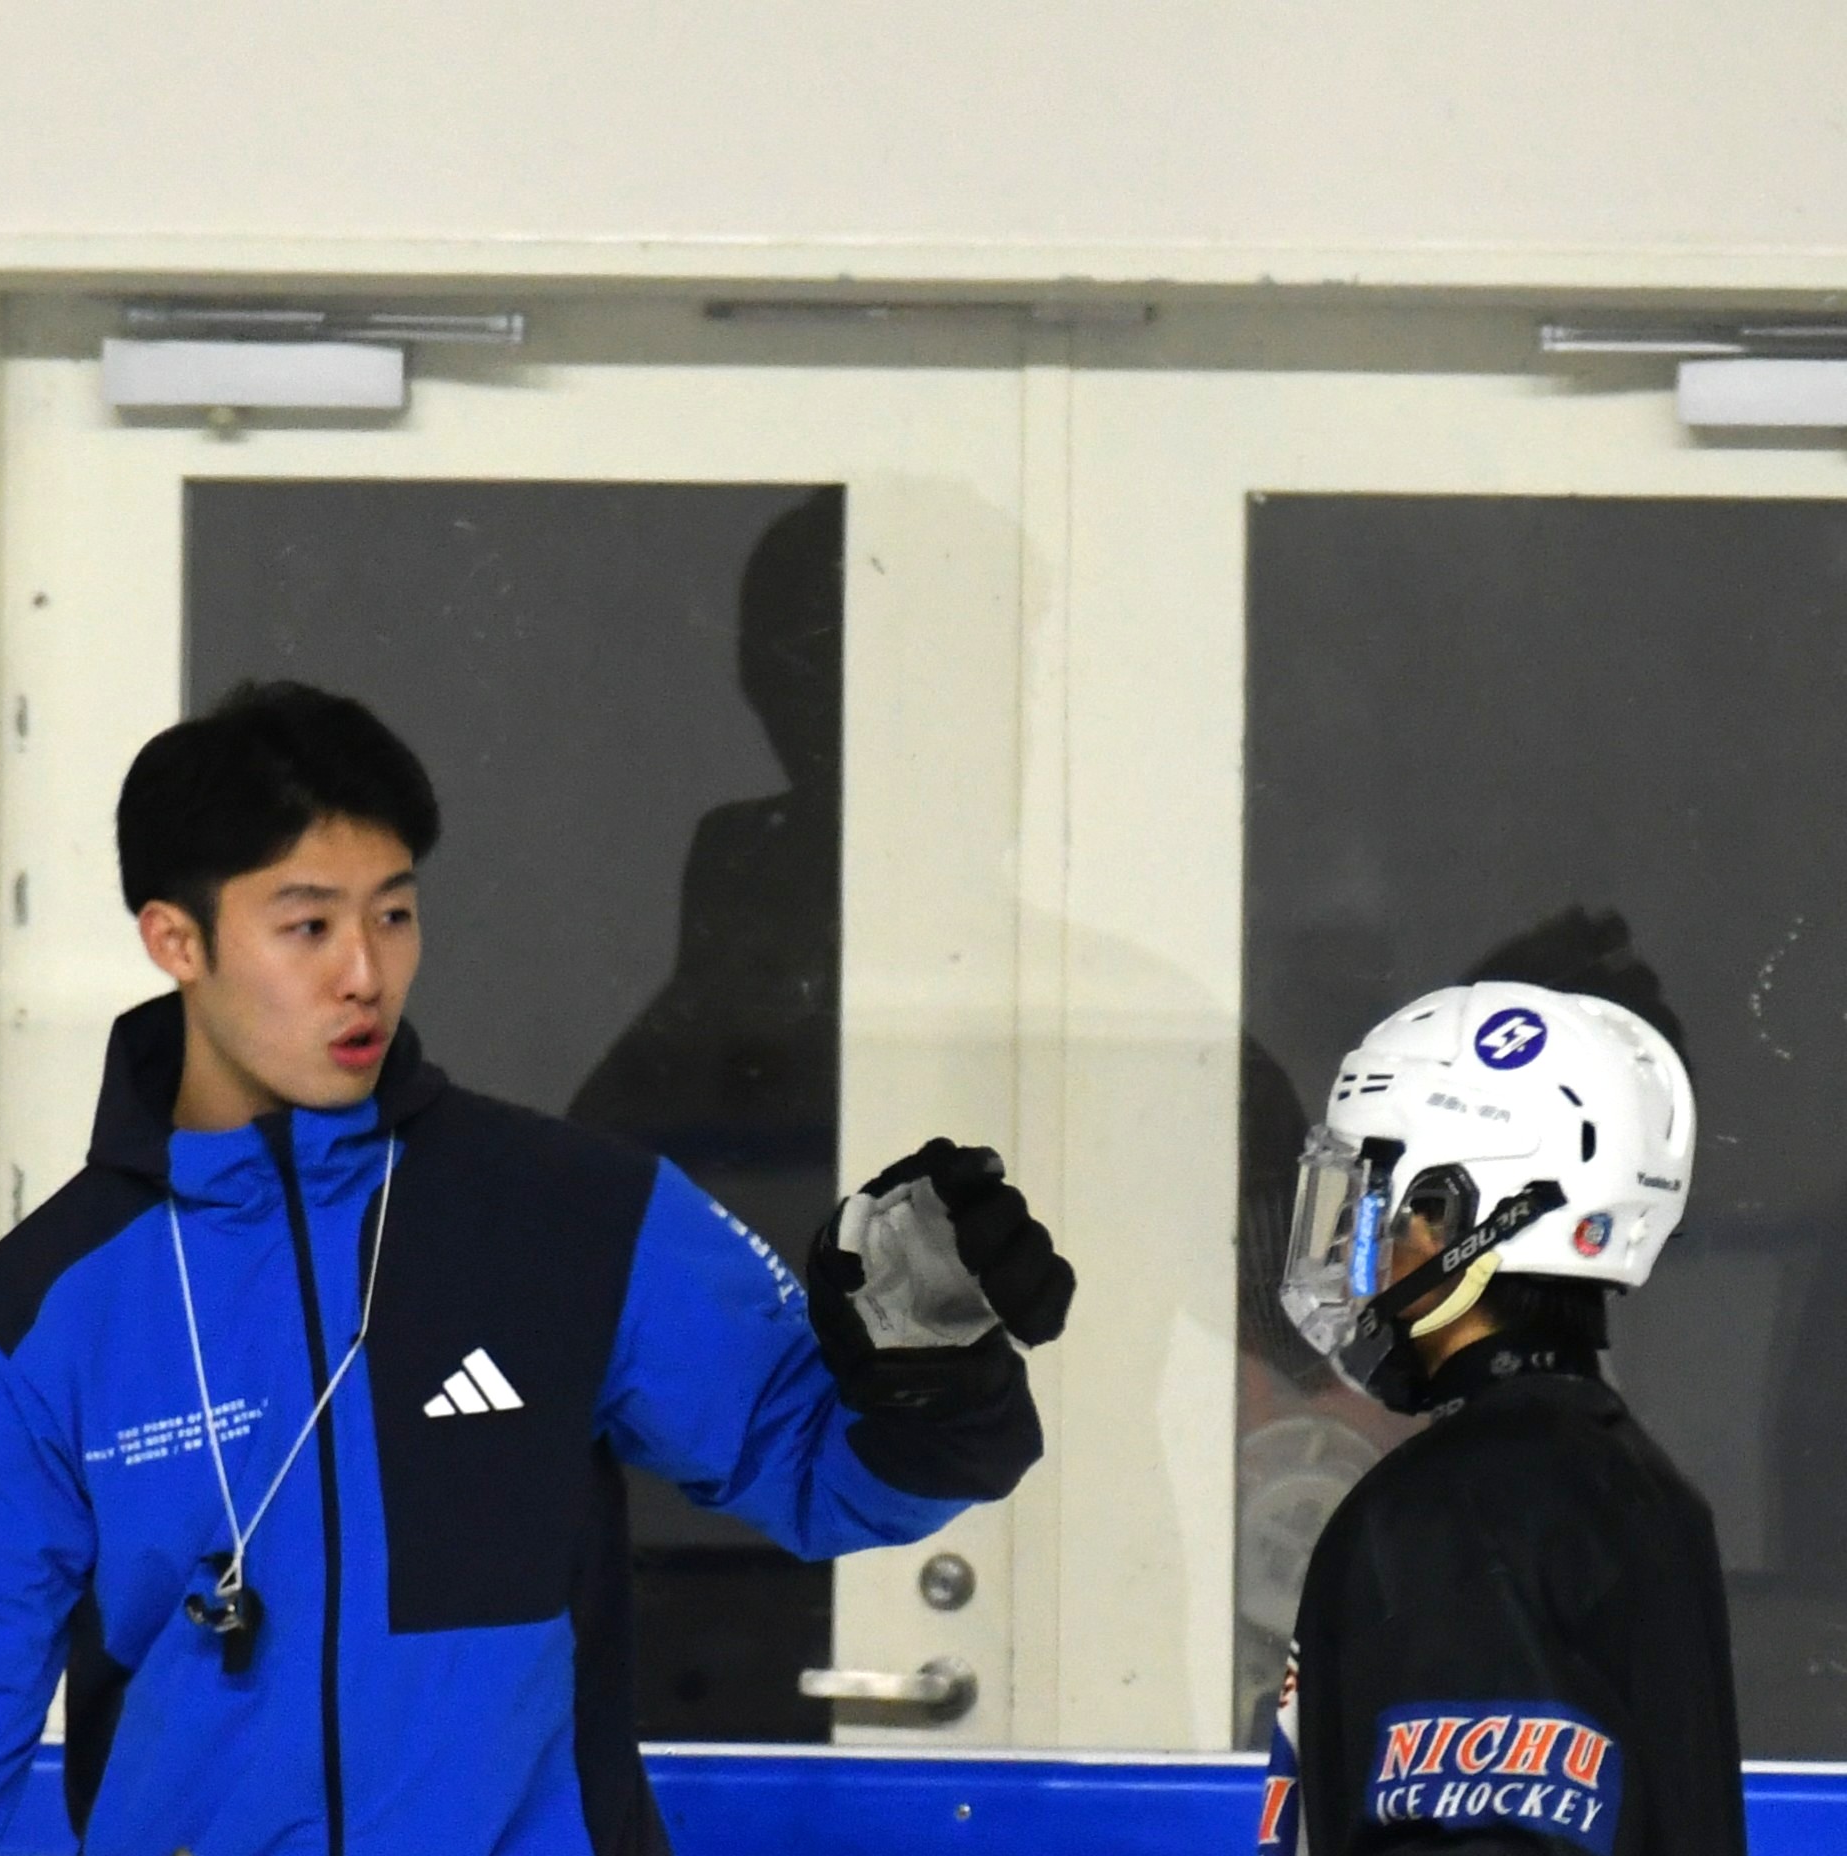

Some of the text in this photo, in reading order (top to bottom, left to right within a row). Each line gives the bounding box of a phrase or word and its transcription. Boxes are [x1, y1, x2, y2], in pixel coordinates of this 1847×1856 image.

[1426, 1092, 1511, 1123] BAER
[210, 1398, 245, 1416] HREE
[1377, 1715, 1614, 1789] NICHU
[1376, 1781, 1604, 1833] ICE HOCKEY
